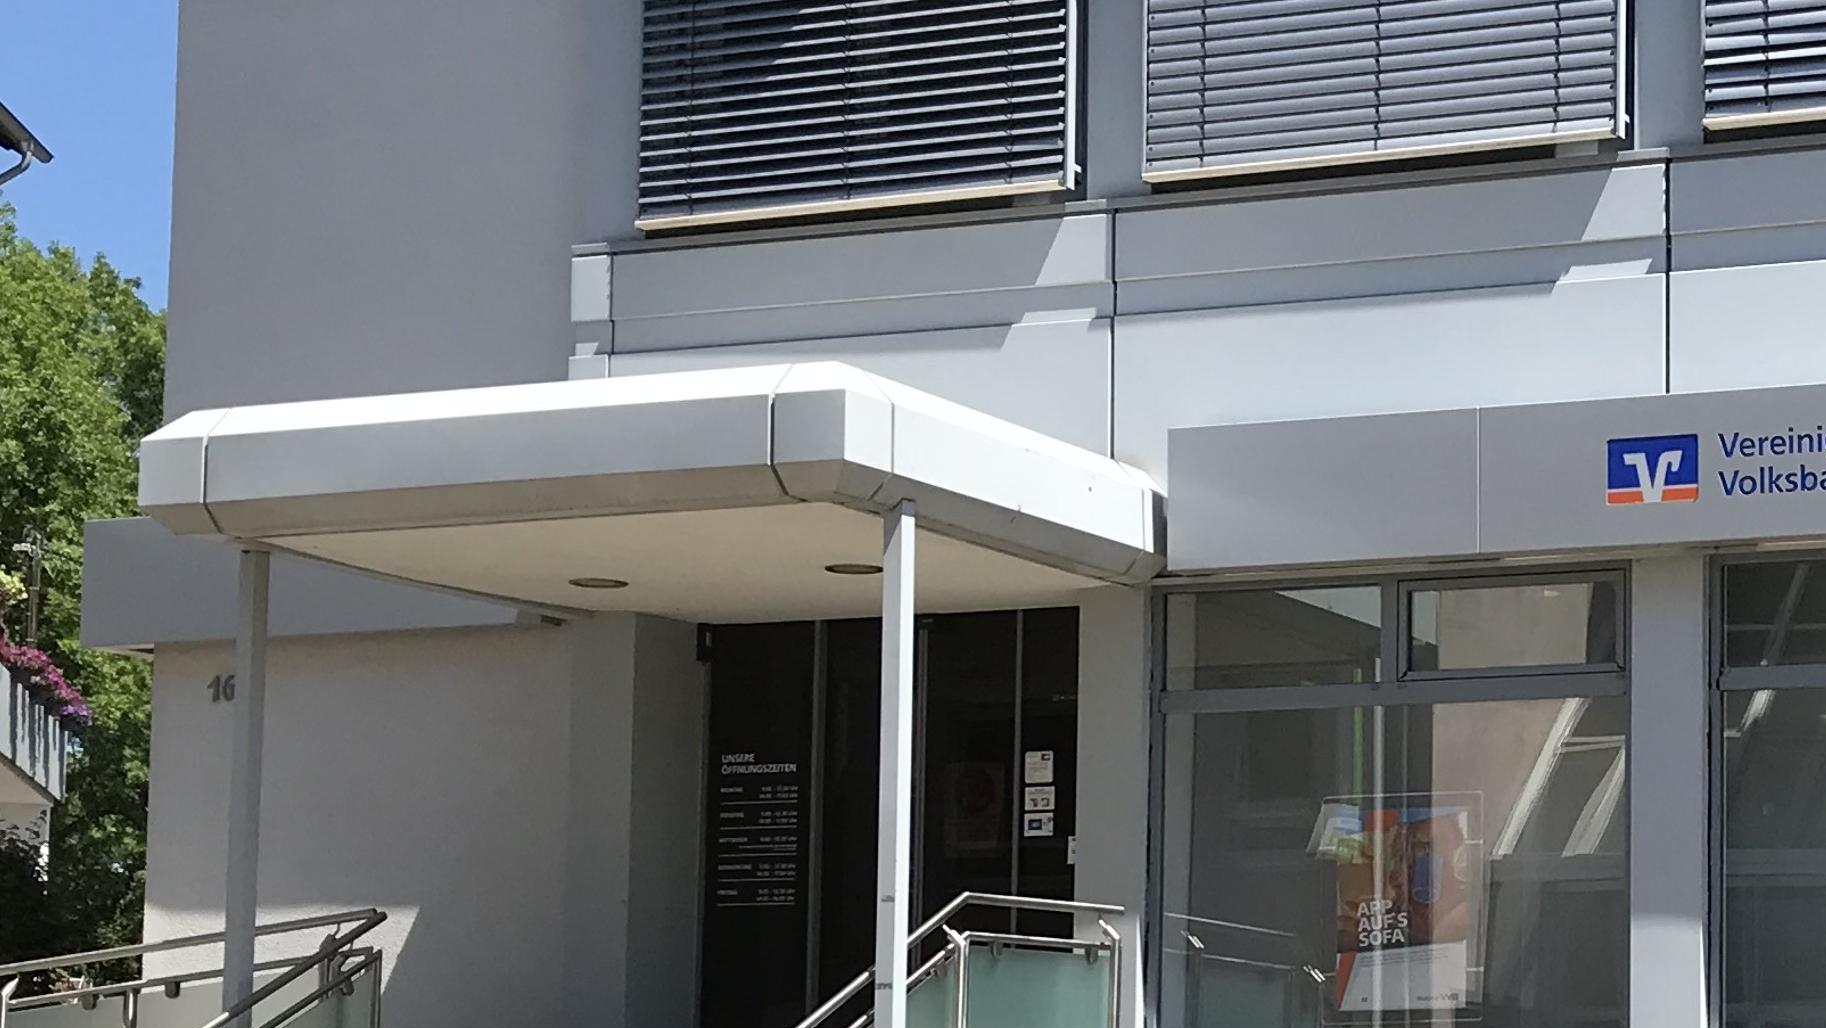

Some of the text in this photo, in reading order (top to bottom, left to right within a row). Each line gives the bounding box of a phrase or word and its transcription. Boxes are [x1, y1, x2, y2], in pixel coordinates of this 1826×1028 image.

[721, 753, 755, 763] UNSERE
[1357, 899, 1393, 917] APP
[1358, 928, 1405, 947] SOFA
